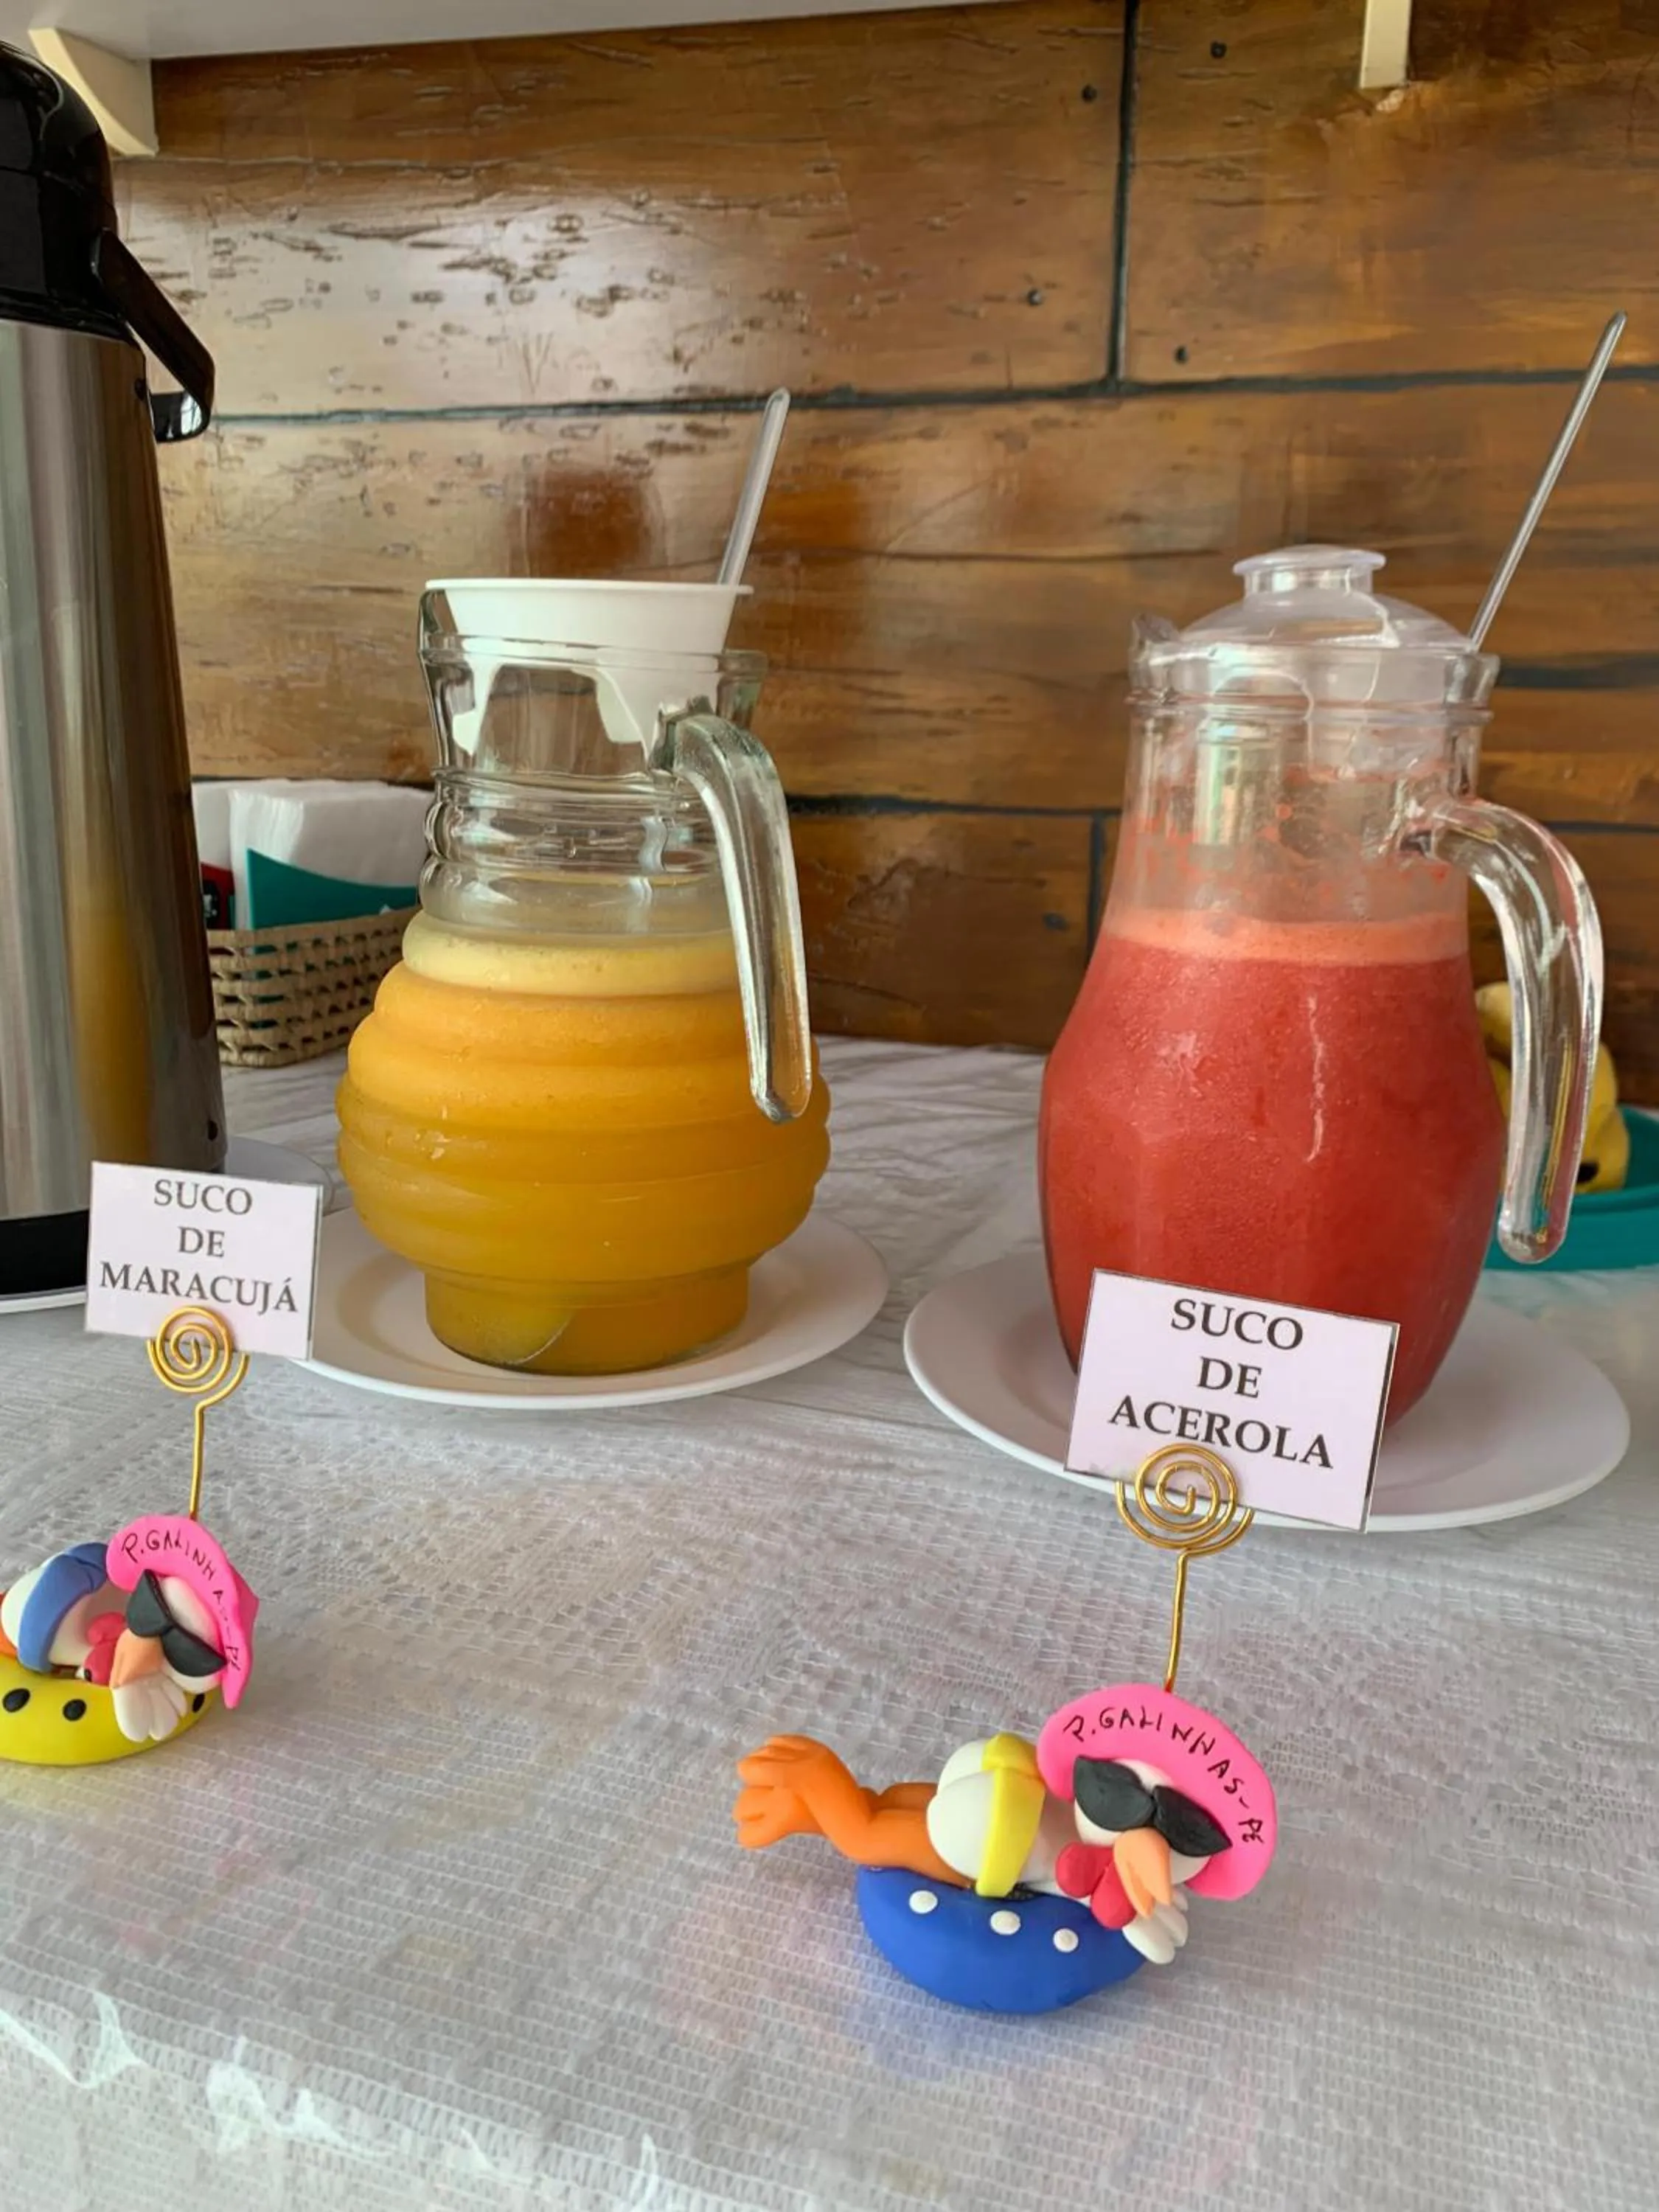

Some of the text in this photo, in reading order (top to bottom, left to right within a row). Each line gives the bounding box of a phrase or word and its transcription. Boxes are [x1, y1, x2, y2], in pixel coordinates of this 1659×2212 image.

[153, 1179, 253, 1215] SUCO
[178, 1225, 225, 1258] DE
[99, 1260, 298, 1316] MARACUJÁ
[1170, 1298, 1304, 1351] SUCO
[1196, 1356, 1263, 1399] DE
[1108, 1394, 1334, 1470] ACEROLA
